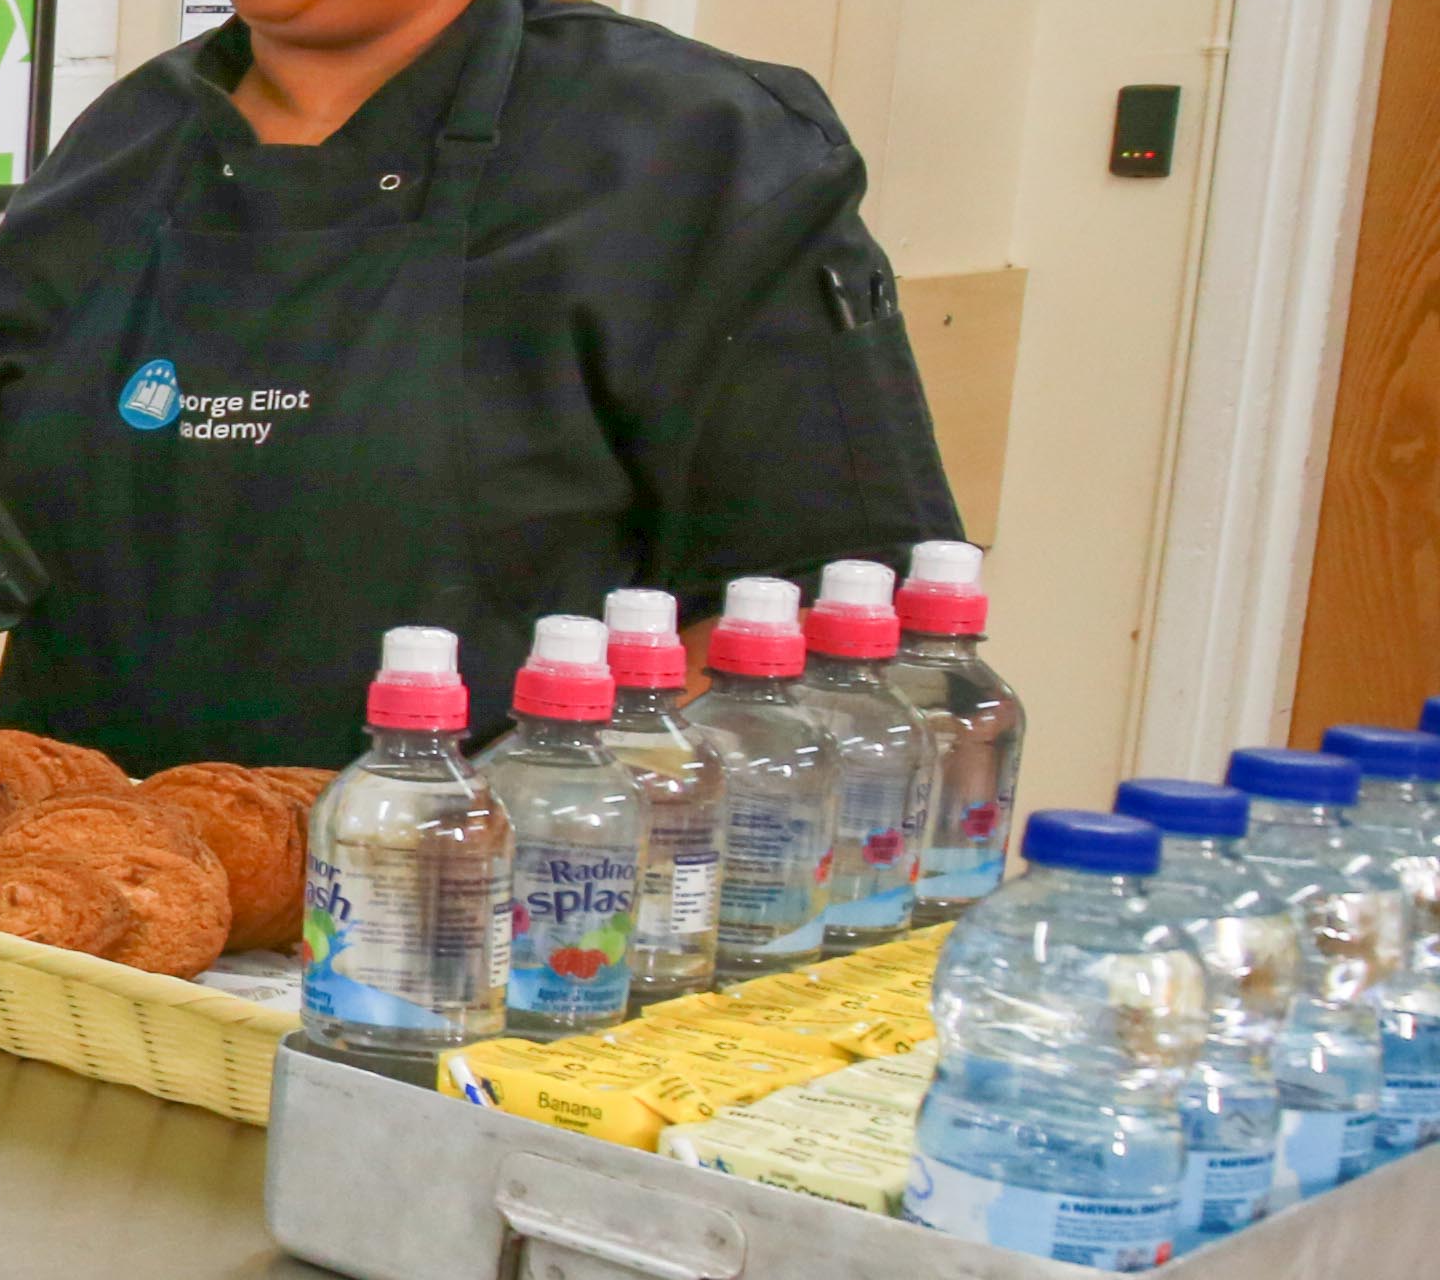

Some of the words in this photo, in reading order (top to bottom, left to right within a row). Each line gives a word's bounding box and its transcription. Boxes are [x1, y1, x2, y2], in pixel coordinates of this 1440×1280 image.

[179, 393, 244, 418] eorge
[250, 389, 310, 412] Eliot
[539, 1091, 602, 1120] Banana
